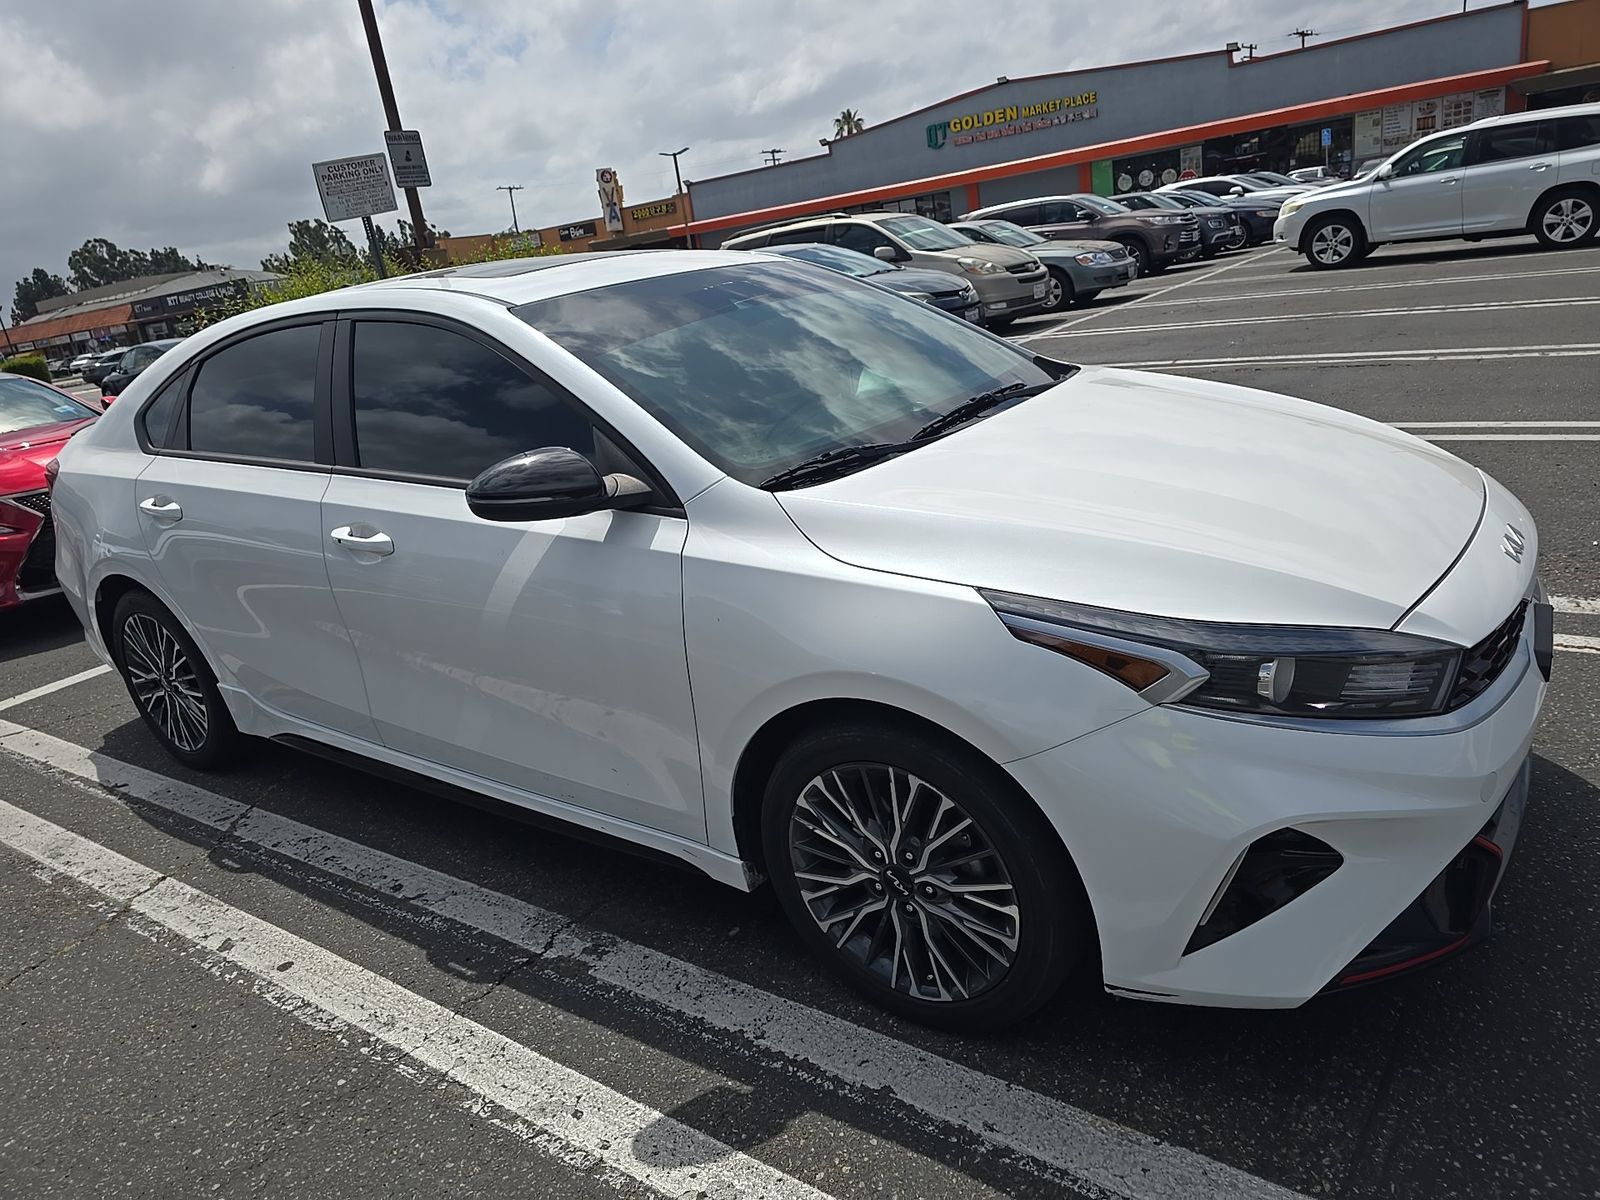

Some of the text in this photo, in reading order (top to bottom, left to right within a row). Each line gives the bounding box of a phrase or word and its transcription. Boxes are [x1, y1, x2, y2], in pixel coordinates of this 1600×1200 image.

[950, 105, 1019, 133] GOLDEN
[1022, 98, 1063, 119] MARKET
[1064, 91, 1097, 109] PLACE
[321, 170, 361, 182] PARKING
[363, 165, 384, 176] ONLY
[327, 160, 376, 173] CUSTOMER
